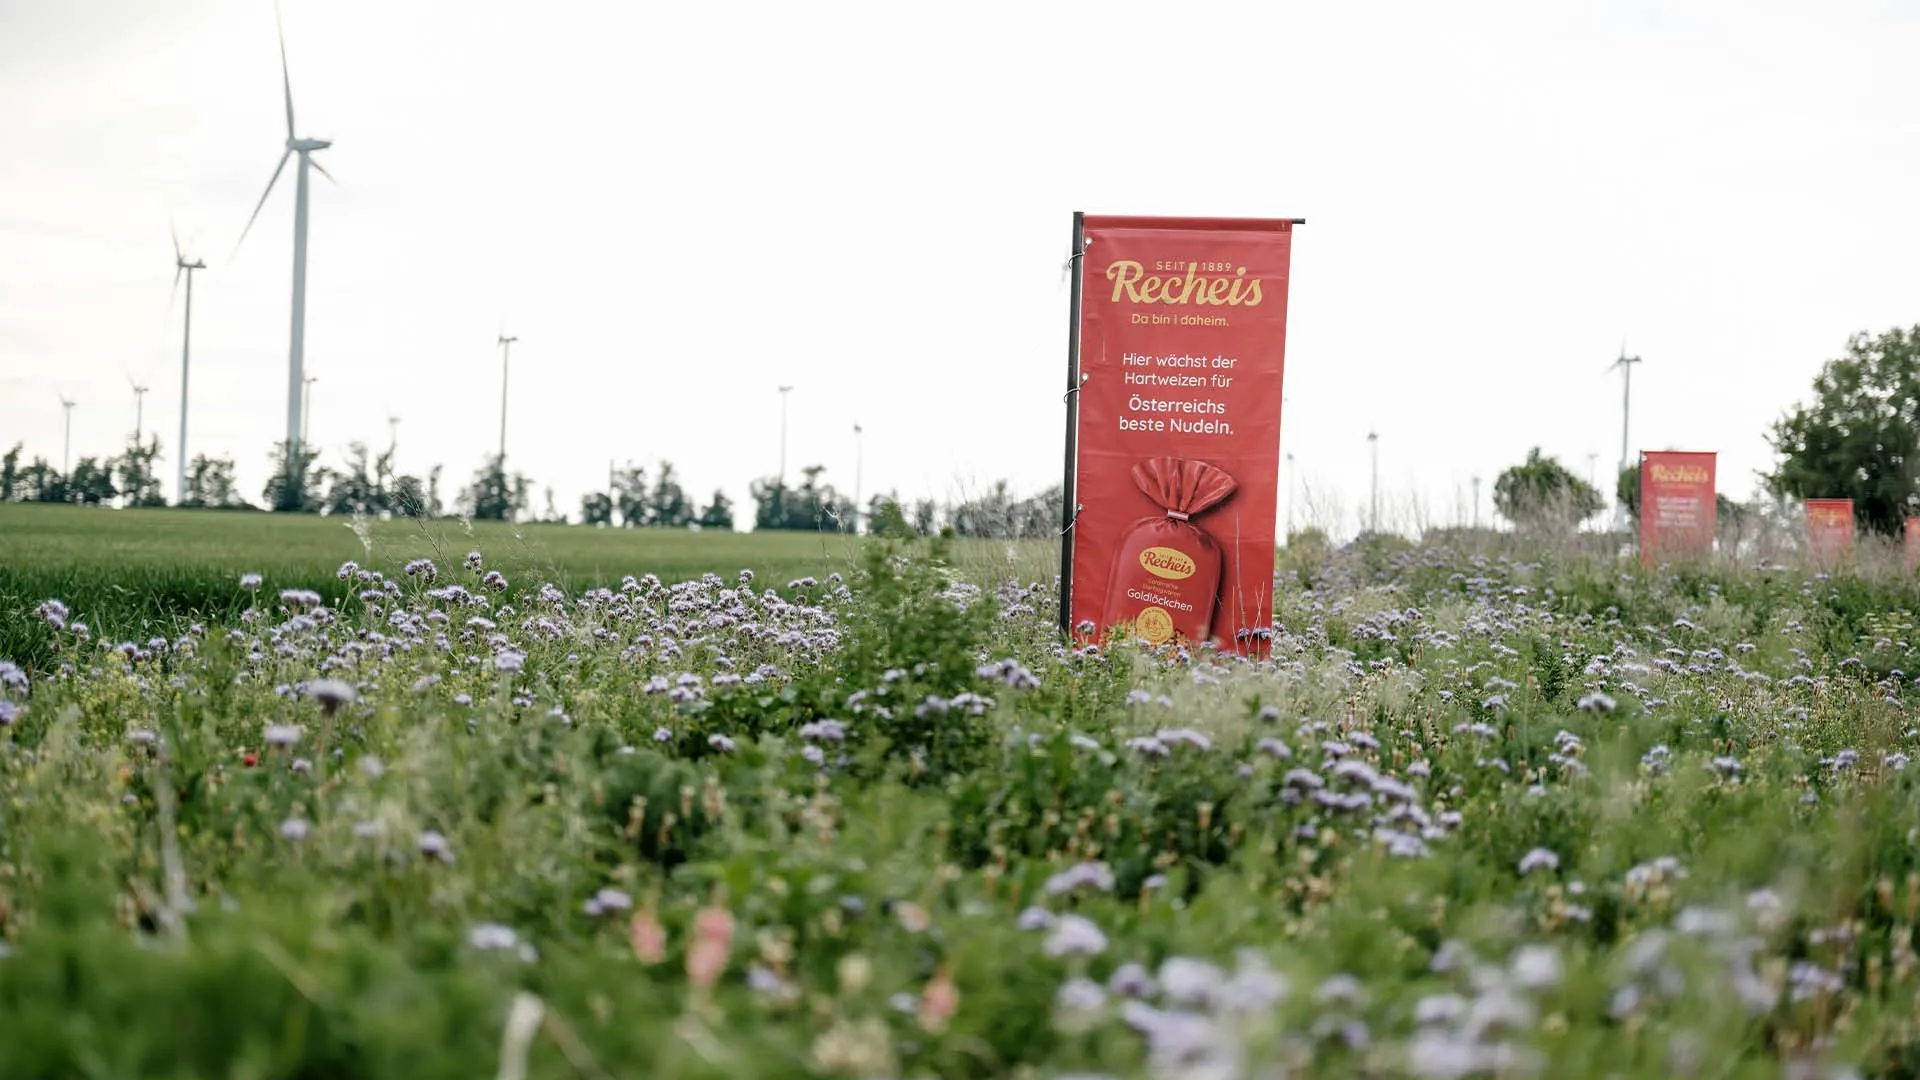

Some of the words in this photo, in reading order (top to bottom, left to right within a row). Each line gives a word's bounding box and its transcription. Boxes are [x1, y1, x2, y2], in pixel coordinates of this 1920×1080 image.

[1156, 261, 1185, 271] SEIT
[1202, 262, 1232, 272] 1889
[1106, 260, 1263, 306] Recheis
[1131, 313, 1149, 325] Da
[1152, 313, 1170, 325] bin
[1180, 314, 1230, 327] daheim.
[1123, 353, 1152, 366] Hier
[1156, 354, 1207, 368] wächst
[1211, 355, 1238, 369] der
[1125, 372, 1206, 387] Hartweizen
[1211, 374, 1233, 388] für
[1129, 394, 1225, 414] Österreichs
[1119, 416, 1165, 431] beste
[1170, 418, 1234, 435] Nudeln.
[1143, 551, 1192, 575] Recheis
[1127, 588, 1193, 612] Goldlöckchen
